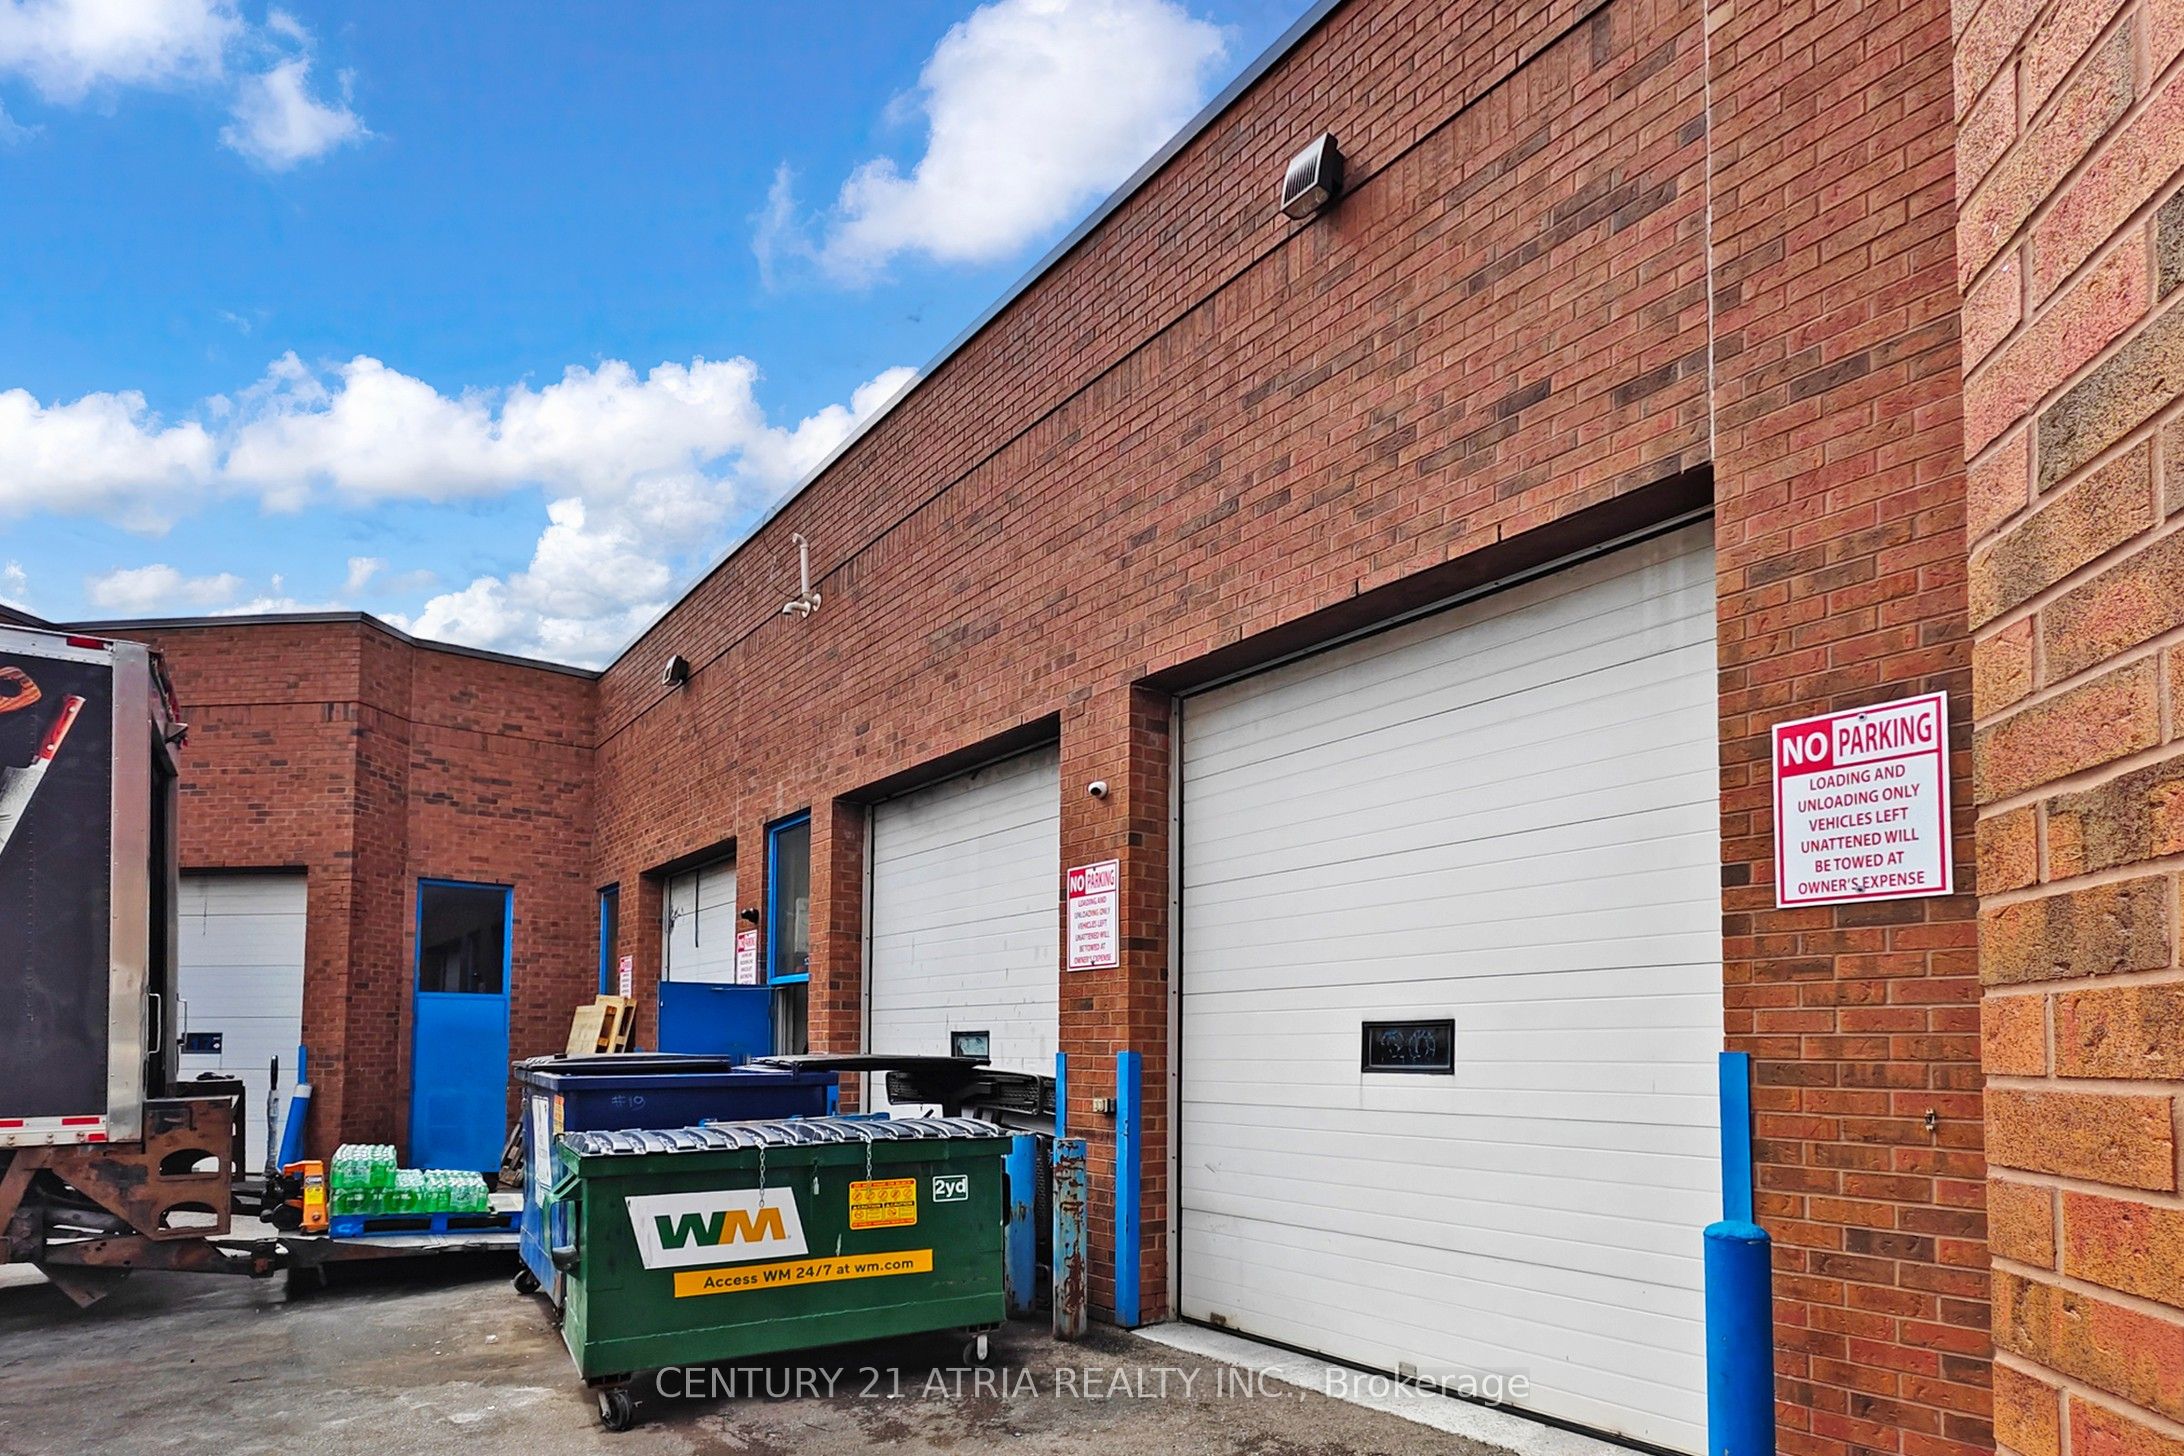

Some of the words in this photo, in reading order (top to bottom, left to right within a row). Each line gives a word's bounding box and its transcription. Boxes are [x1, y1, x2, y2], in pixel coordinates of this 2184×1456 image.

[1782, 731, 1828, 767] NO
[1838, 712, 1932, 757] PARKING
[1809, 770, 1870, 791] LOADING
[1875, 764, 1905, 781] AND
[1798, 790, 1878, 813] UNLOADING
[1882, 784, 1920, 799] ONLY
[1809, 812, 1872, 832] VEHICLES
[1876, 807, 1909, 823] LEFT
[1801, 832, 1881, 853] UNATTENED
[1884, 828, 1919, 844] WILL
[1815, 859, 1831, 872] BE
[1833, 854, 1883, 870] TOWED
[1887, 851, 1904, 865] AT
[1070, 875, 1085, 893] NO
[1087, 870, 1114, 889] PARKING
[1798, 878, 1858, 894] OWNER'S
[1862, 871, 1925, 889] EXPENSE
[935, 1178, 966, 1197] 2yd
[654, 1207, 787, 1250] WM
[703, 1274, 758, 1289] Access
[763, 1269, 791, 1283] WM
[796, 1263, 832, 1279] 24/7
[836, 1263, 850, 1275] at
[855, 1258, 914, 1273] wm.com
